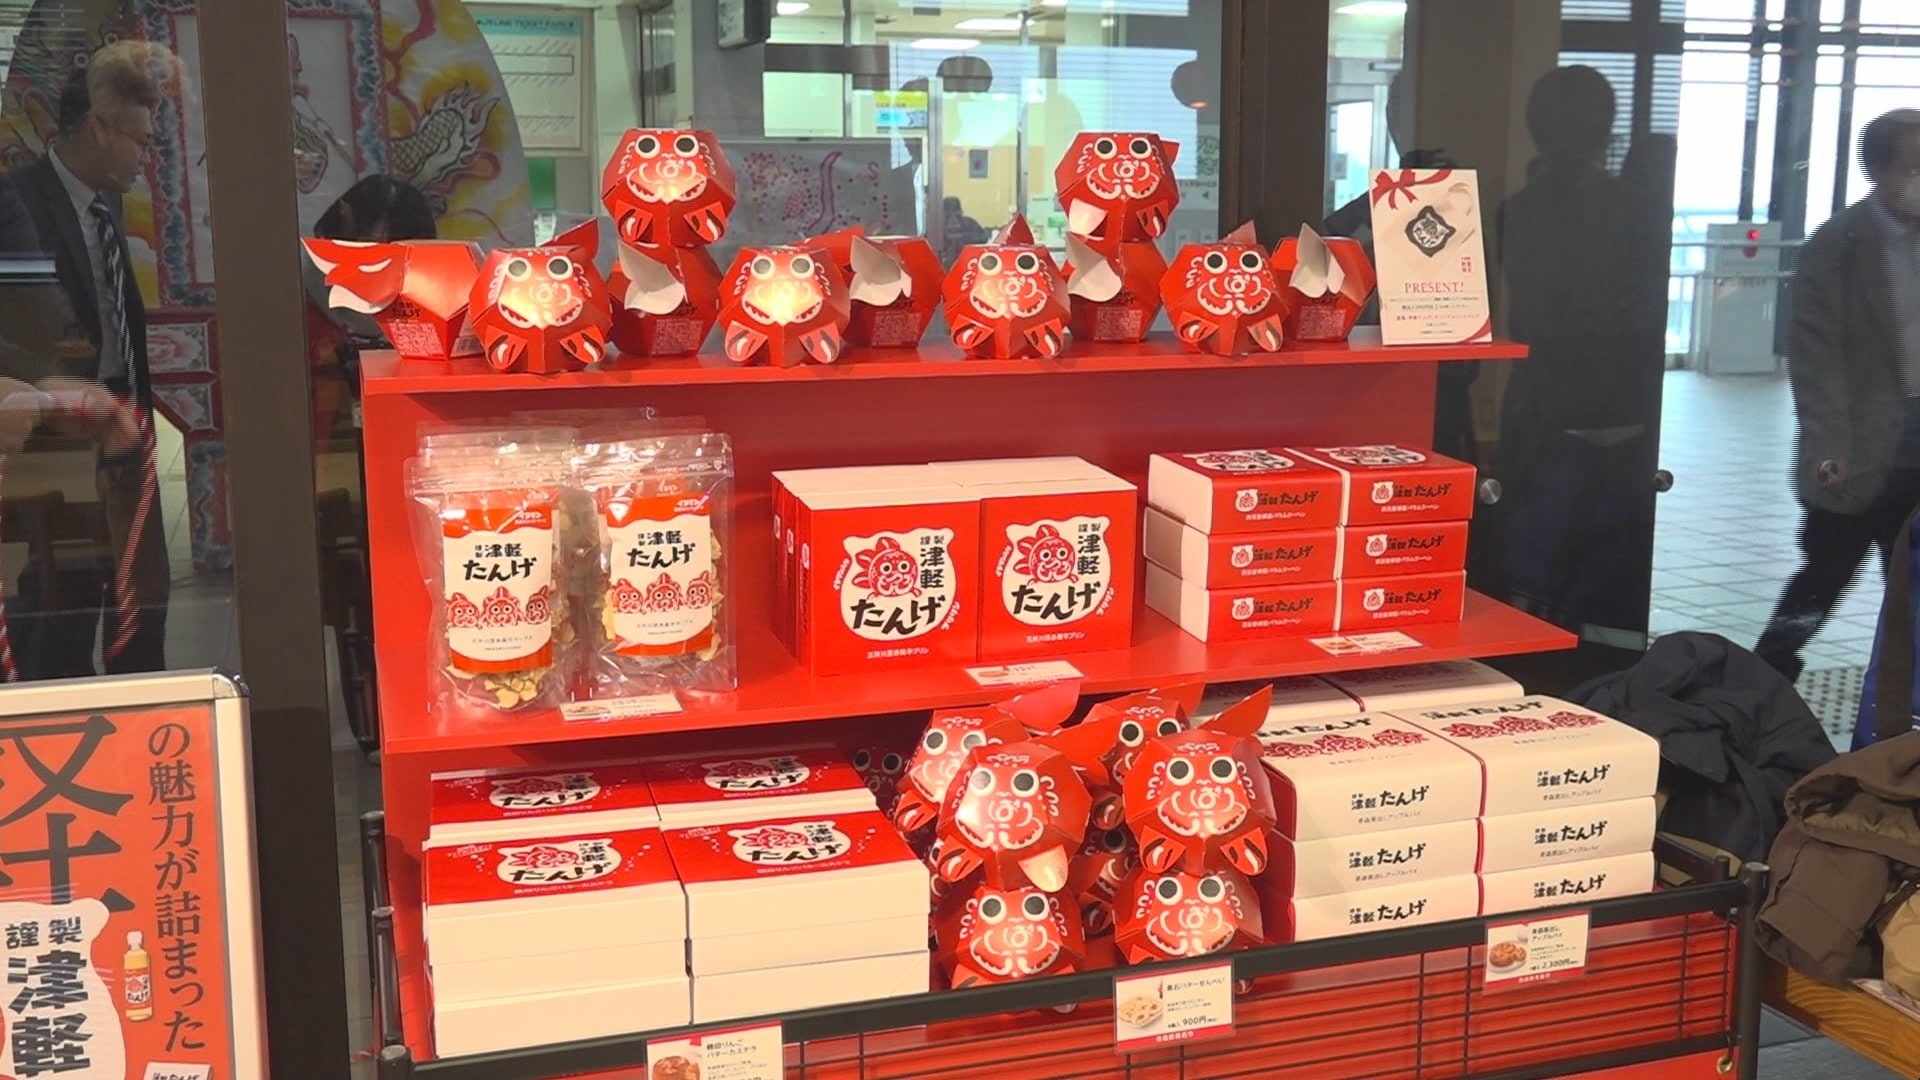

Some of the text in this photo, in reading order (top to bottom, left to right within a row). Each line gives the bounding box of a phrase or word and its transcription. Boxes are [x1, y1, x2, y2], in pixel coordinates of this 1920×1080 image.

[1405, 282, 1464, 293] PRESENT!
[647, 530, 682, 545] 津軽
[485, 543, 522, 558] 津軽
[627, 543, 696, 569] たんげ
[1077, 534, 1101, 575] 津軽
[463, 557, 537, 582] たんげ
[920, 546, 945, 589] 津軽
[1011, 581, 1101, 620] たんげ
[850, 595, 946, 635] たんげ
[716, 773, 802, 789] たんげ
[498, 790, 593, 807] たんげ
[746, 842, 843, 862] たんげ
[509, 861, 612, 882] たんげ
[148, 722, 206, 1052] の魅力が詰まった
[5, 916, 83, 949] 謹製
[8, 950, 93, 1078] 津軽
[1182, 1015, 1207, 1026] 900円
